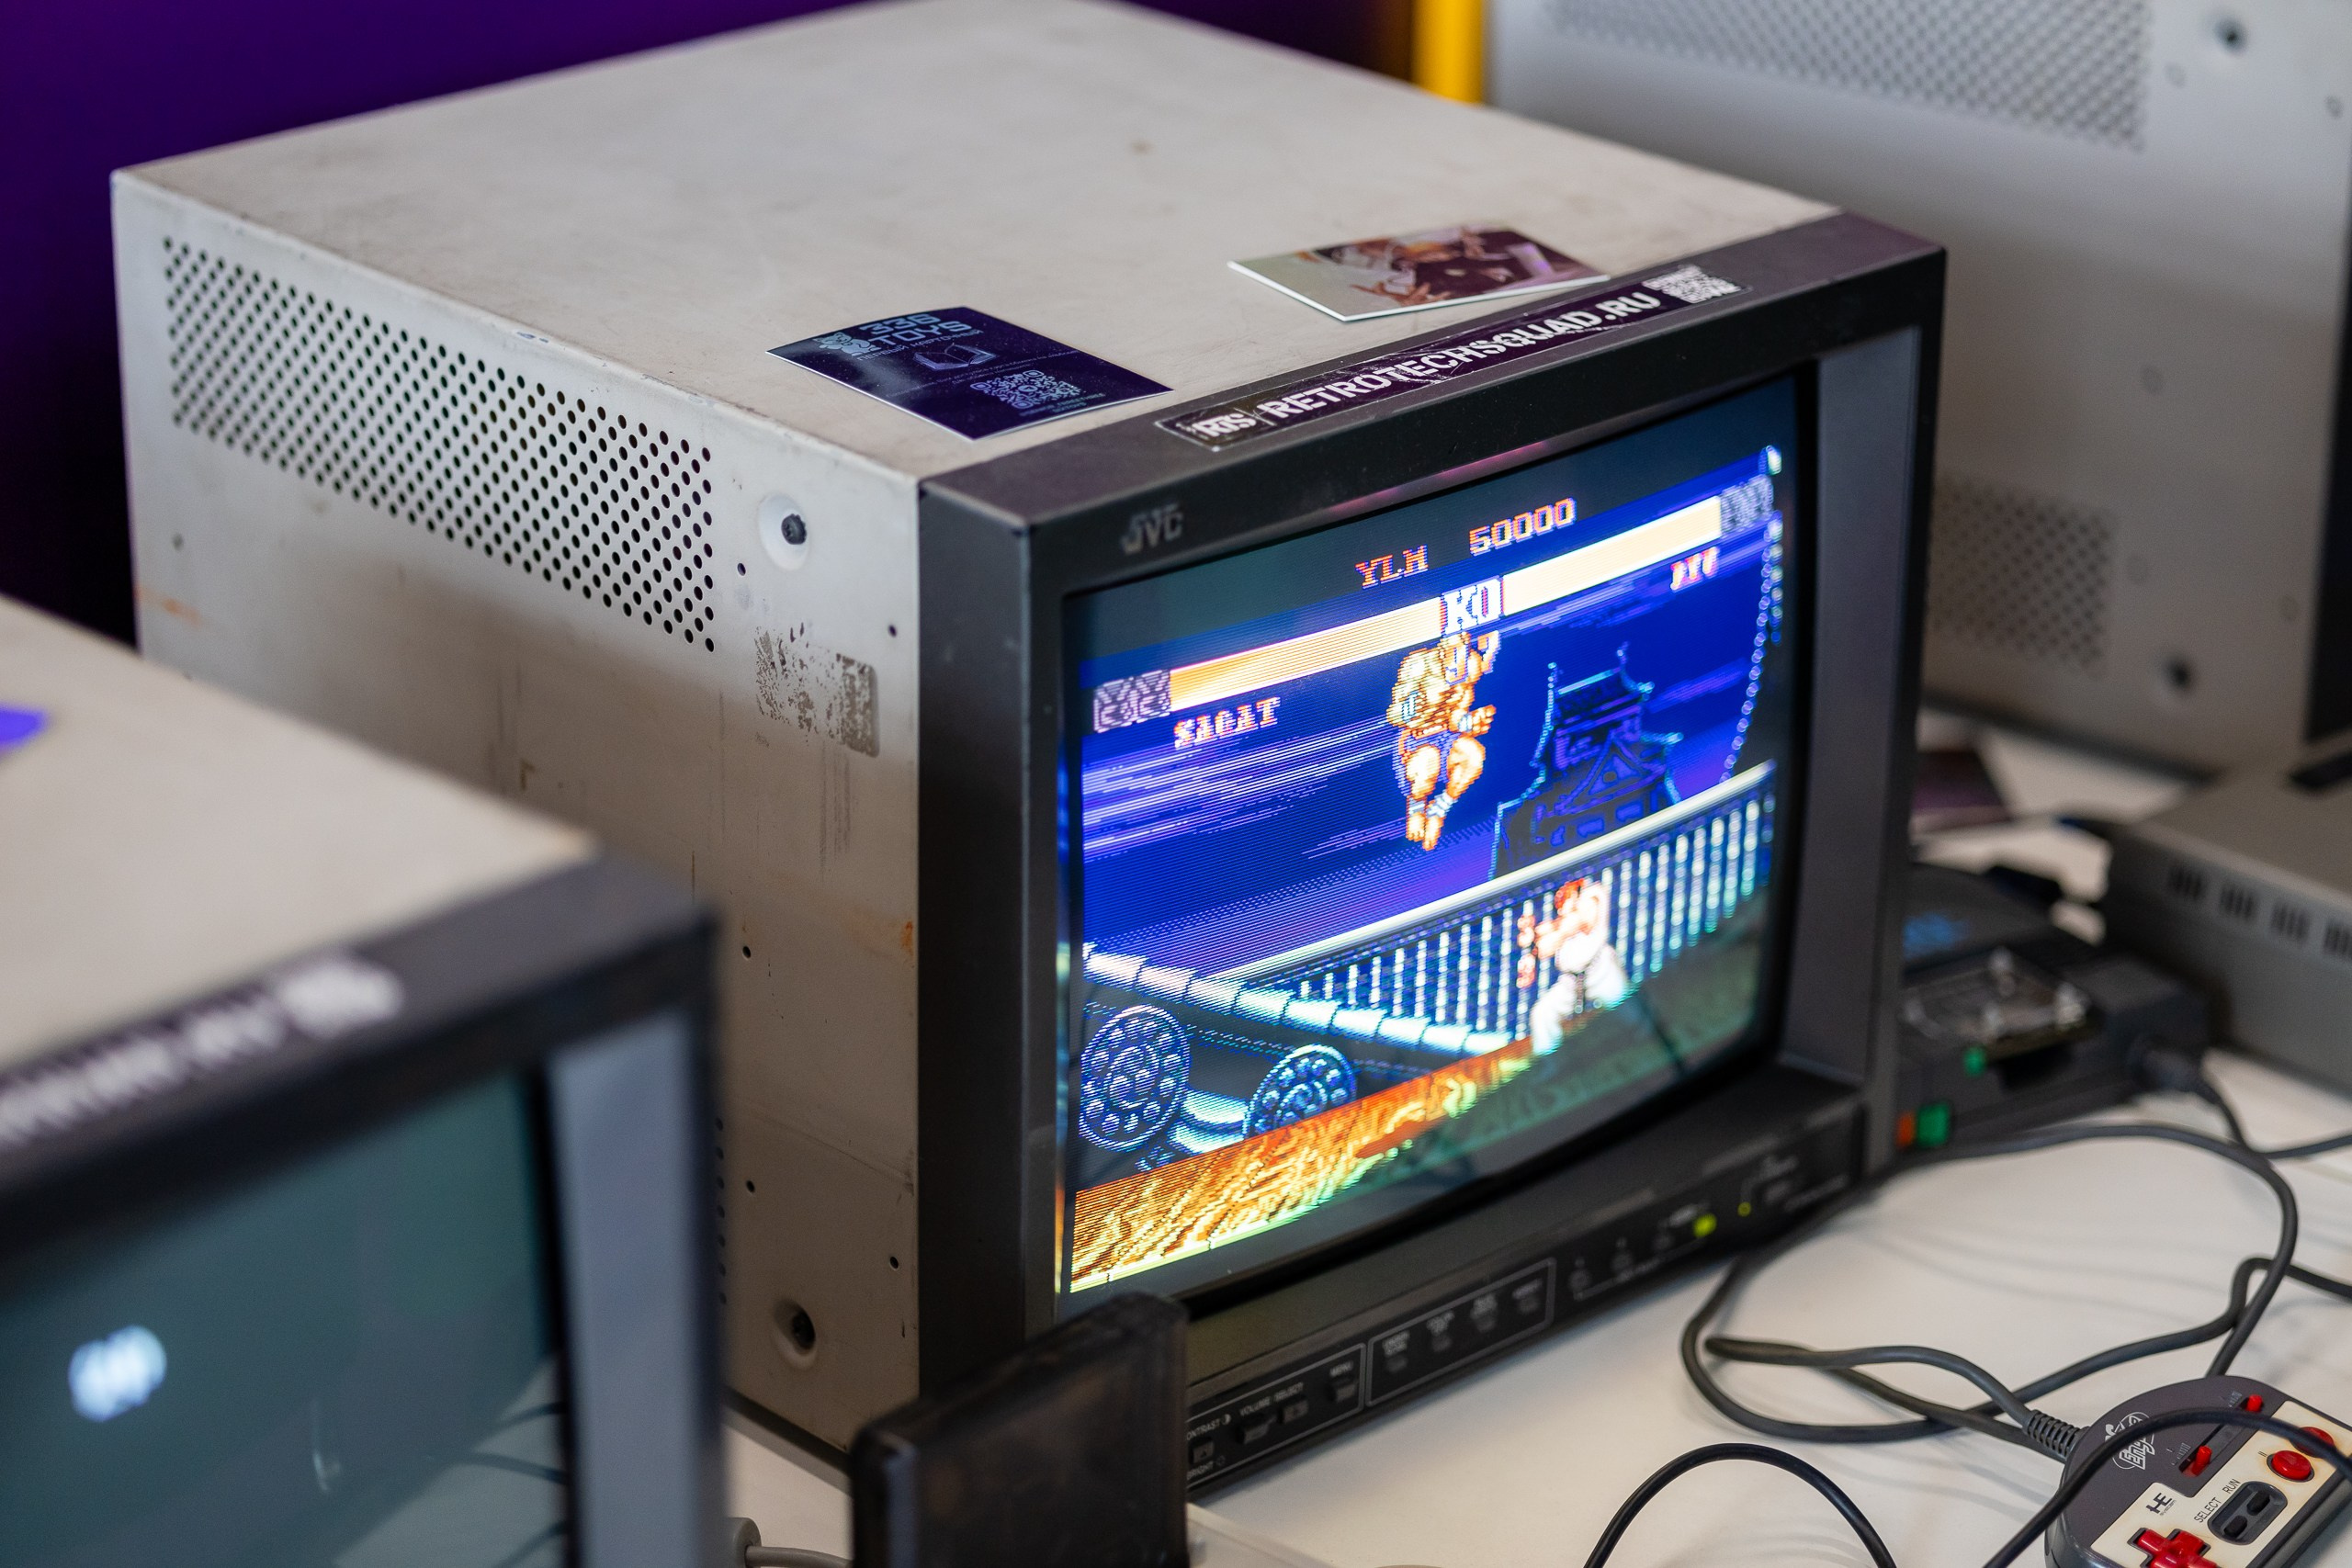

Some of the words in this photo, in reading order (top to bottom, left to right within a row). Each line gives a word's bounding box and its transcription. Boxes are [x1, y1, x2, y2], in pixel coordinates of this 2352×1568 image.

[867, 321, 972, 345] TOYS
[1256, 291, 1662, 420] RETROTECHSQUAD.RU
[1121, 503, 1184, 555] JVC
[1469, 497, 1577, 556] 50000
[1442, 576, 1503, 637] KO
[1173, 696, 1281, 750] SAGAT
[1186, 1418, 1220, 1440] ONTRAST
[2193, 1496, 2222, 1523] SELECT
[2222, 1478, 2242, 1494] RUN
